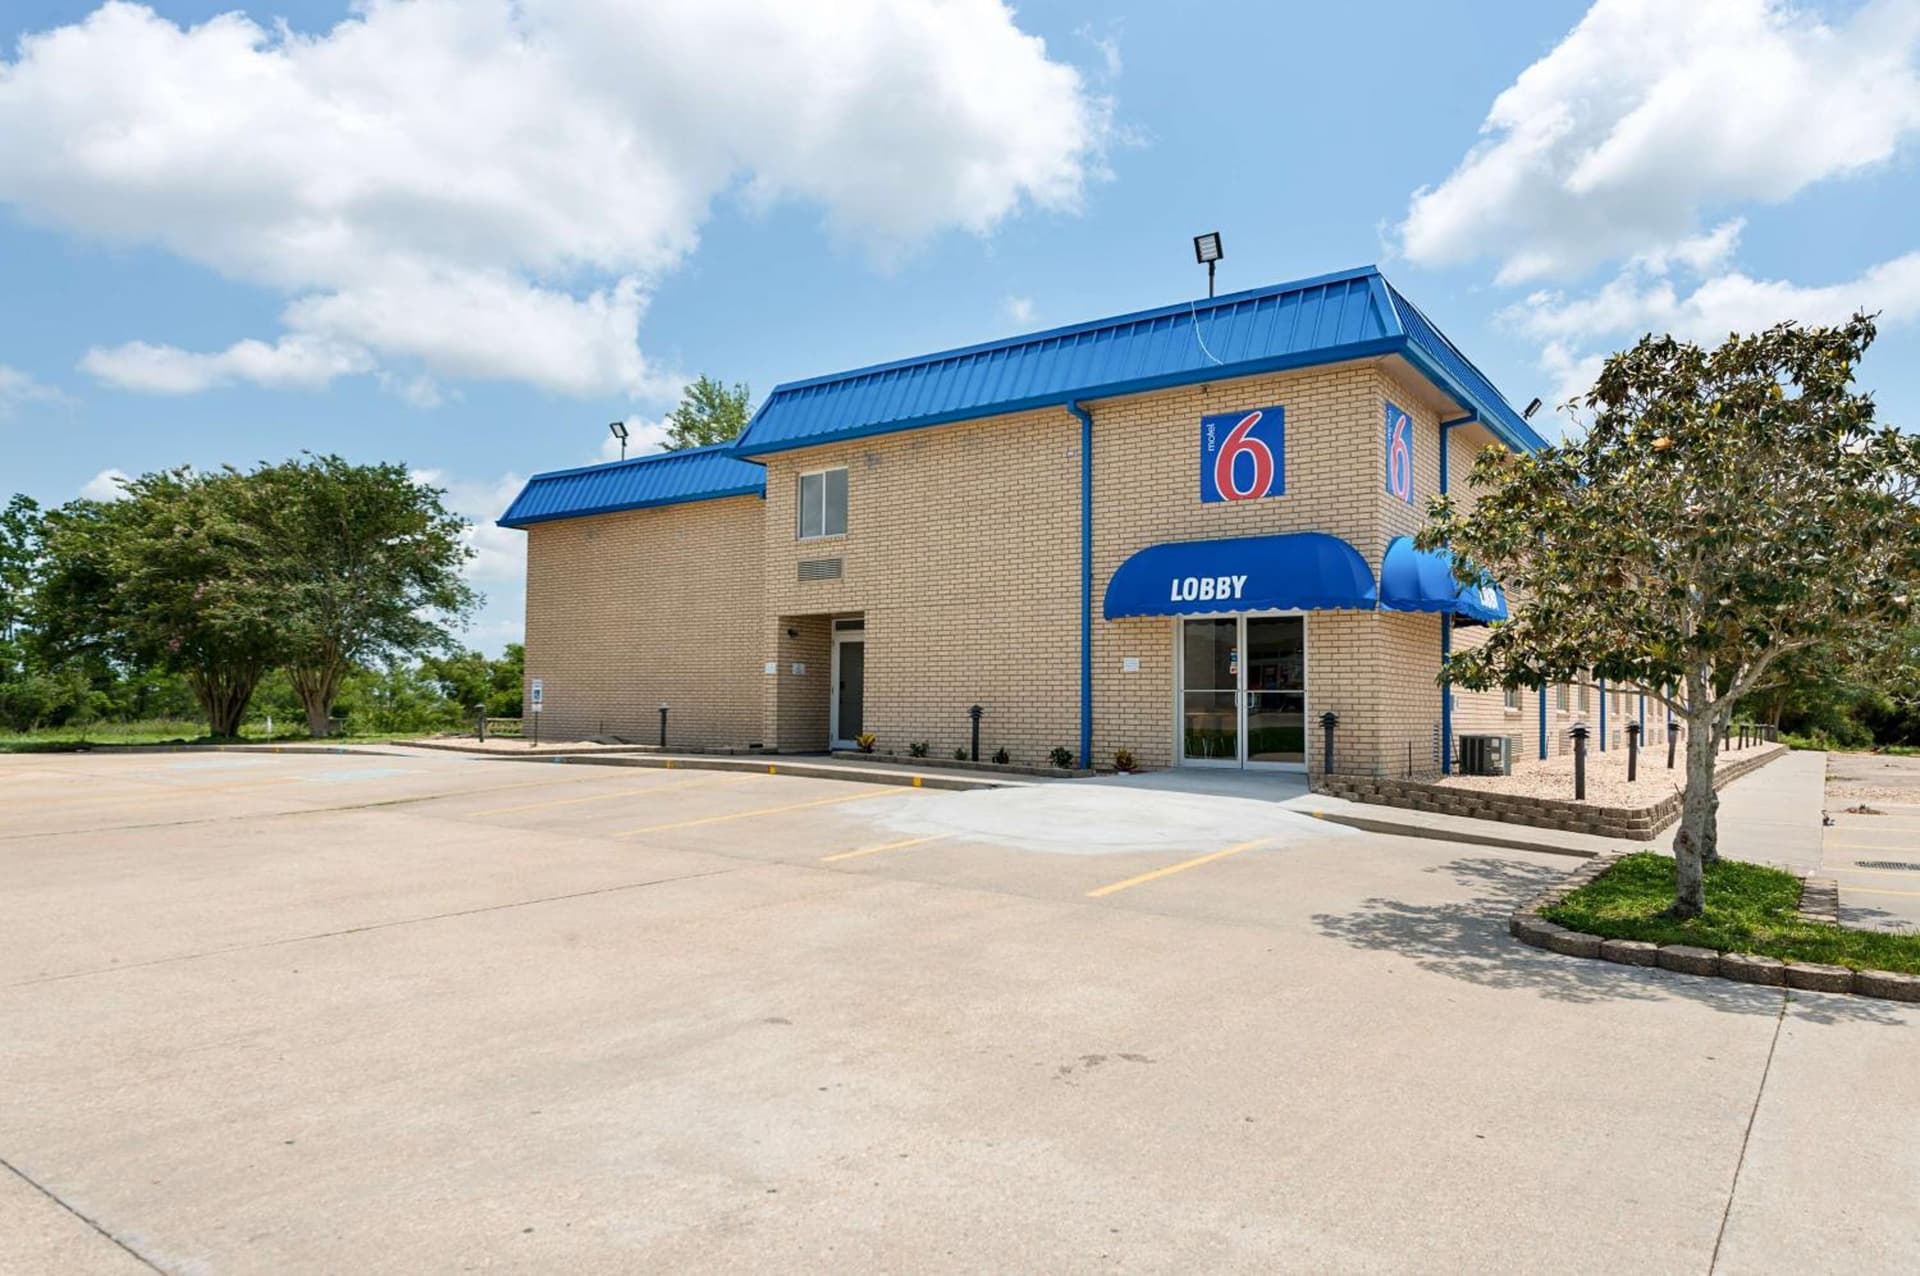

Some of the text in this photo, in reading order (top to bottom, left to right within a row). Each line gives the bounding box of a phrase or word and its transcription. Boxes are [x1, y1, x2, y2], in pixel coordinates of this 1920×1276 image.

[1206, 410, 1274, 501] motel 6
[1391, 414, 1410, 502] 6
[1170, 575, 1248, 601] LOBBY
